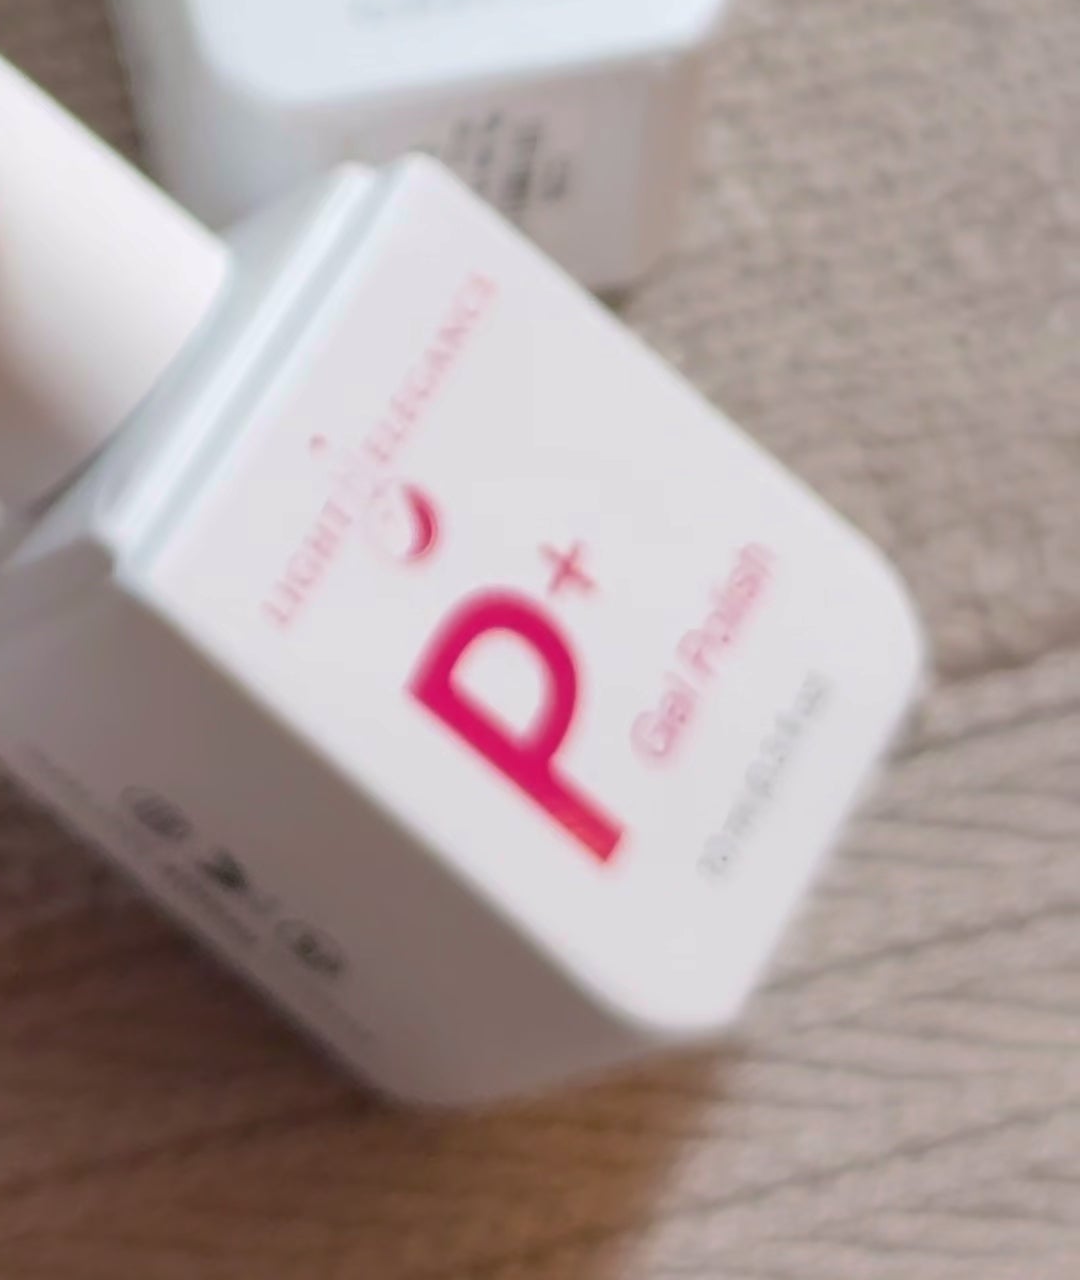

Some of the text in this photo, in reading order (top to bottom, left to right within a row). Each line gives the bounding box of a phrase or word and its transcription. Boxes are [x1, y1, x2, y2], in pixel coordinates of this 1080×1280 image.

[261, 272, 500, 627] LIGHT ELEGANCE
[407, 538, 624, 864] P+
[629, 542, 774, 764] Gel Polish
